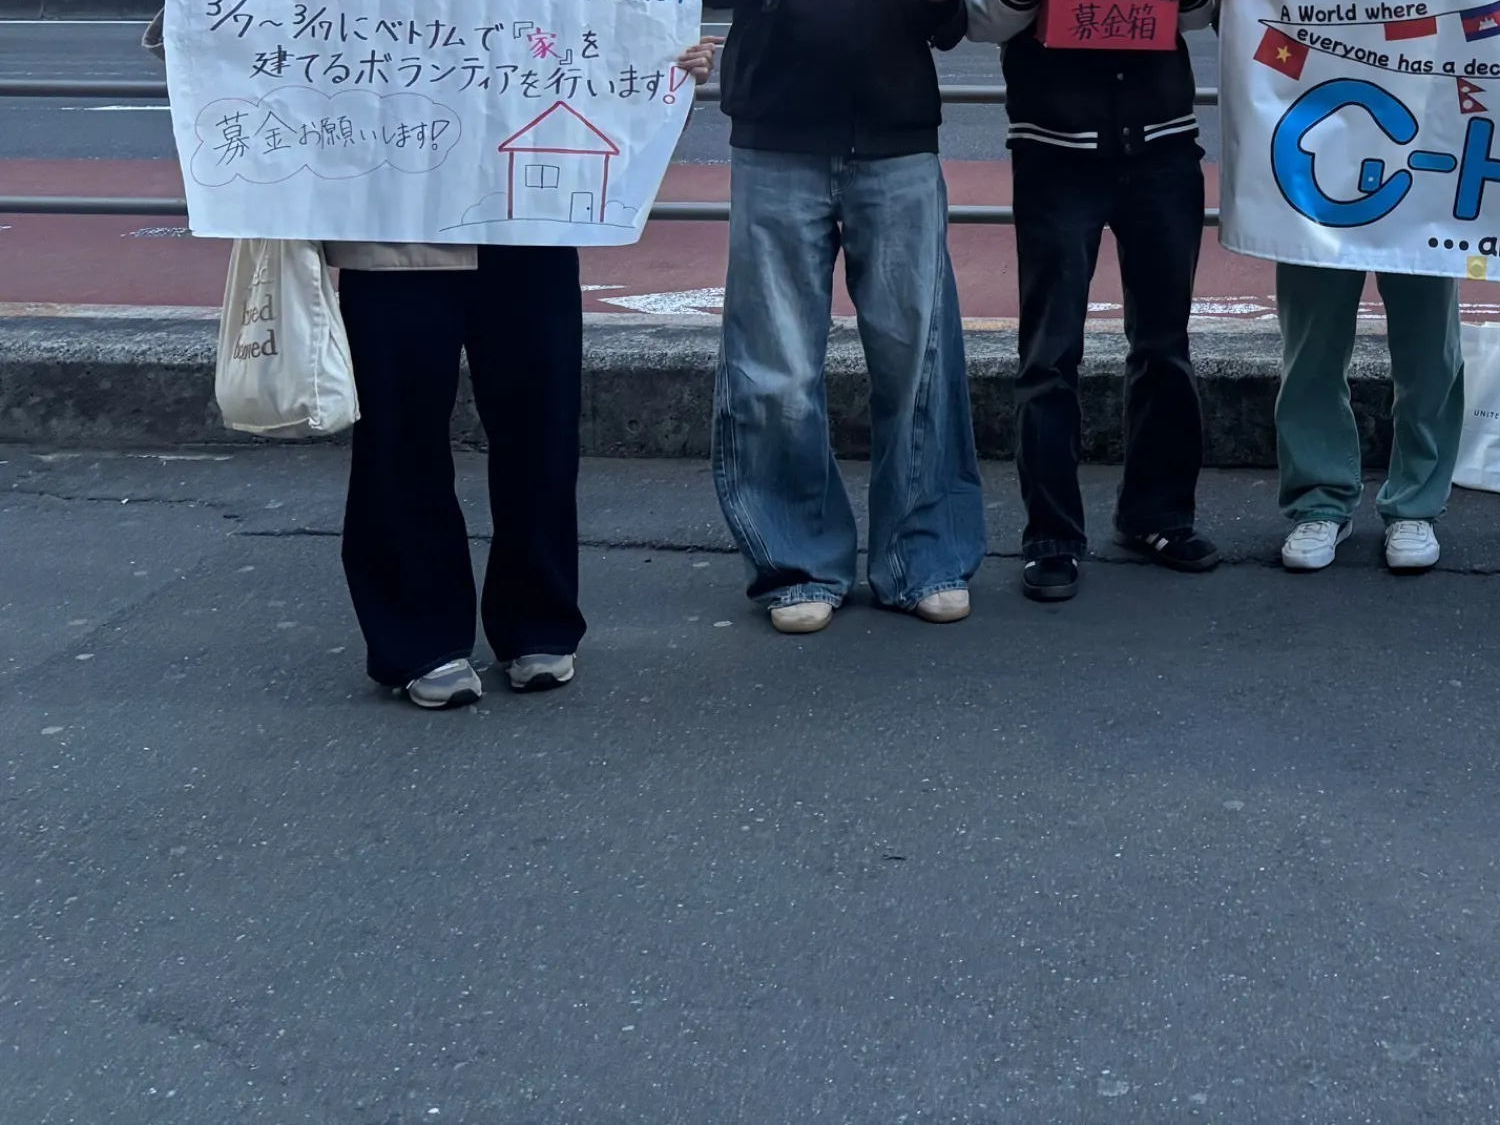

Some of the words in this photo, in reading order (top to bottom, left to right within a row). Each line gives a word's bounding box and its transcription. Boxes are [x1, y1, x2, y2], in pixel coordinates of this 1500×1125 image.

[1069, 2, 1157, 42] 募金箱
[1280, 5, 1291, 22] A
[1299, 3, 1357, 23] World
[1365, 0, 1428, 20] where
[1296, 26, 1389, 68] everyone
[1397, 53, 1434, 73] has
[1442, 60, 1456, 74] a
